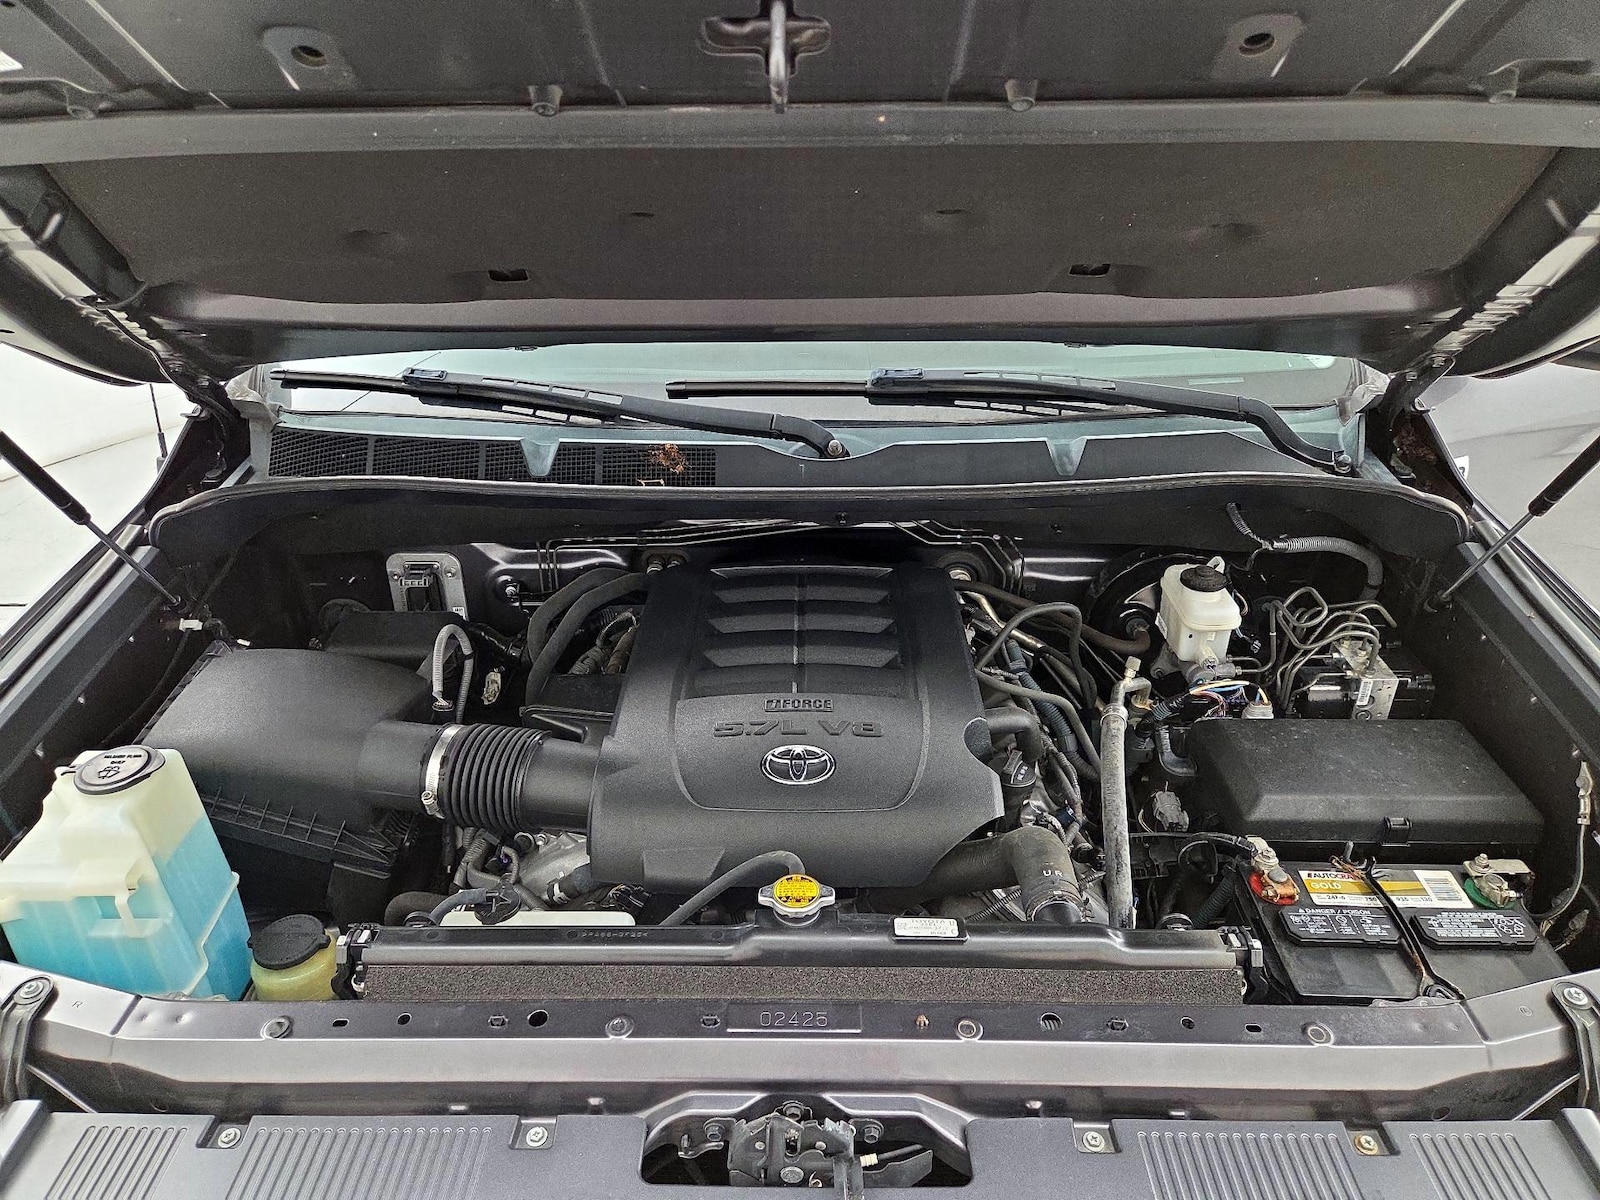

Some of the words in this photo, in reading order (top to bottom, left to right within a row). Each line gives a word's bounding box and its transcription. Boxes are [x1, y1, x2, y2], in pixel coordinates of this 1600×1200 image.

[714, 720, 807, 737] 5.7L
[818, 720, 883, 737] V8
[759, 1011, 828, 1027] 02425
